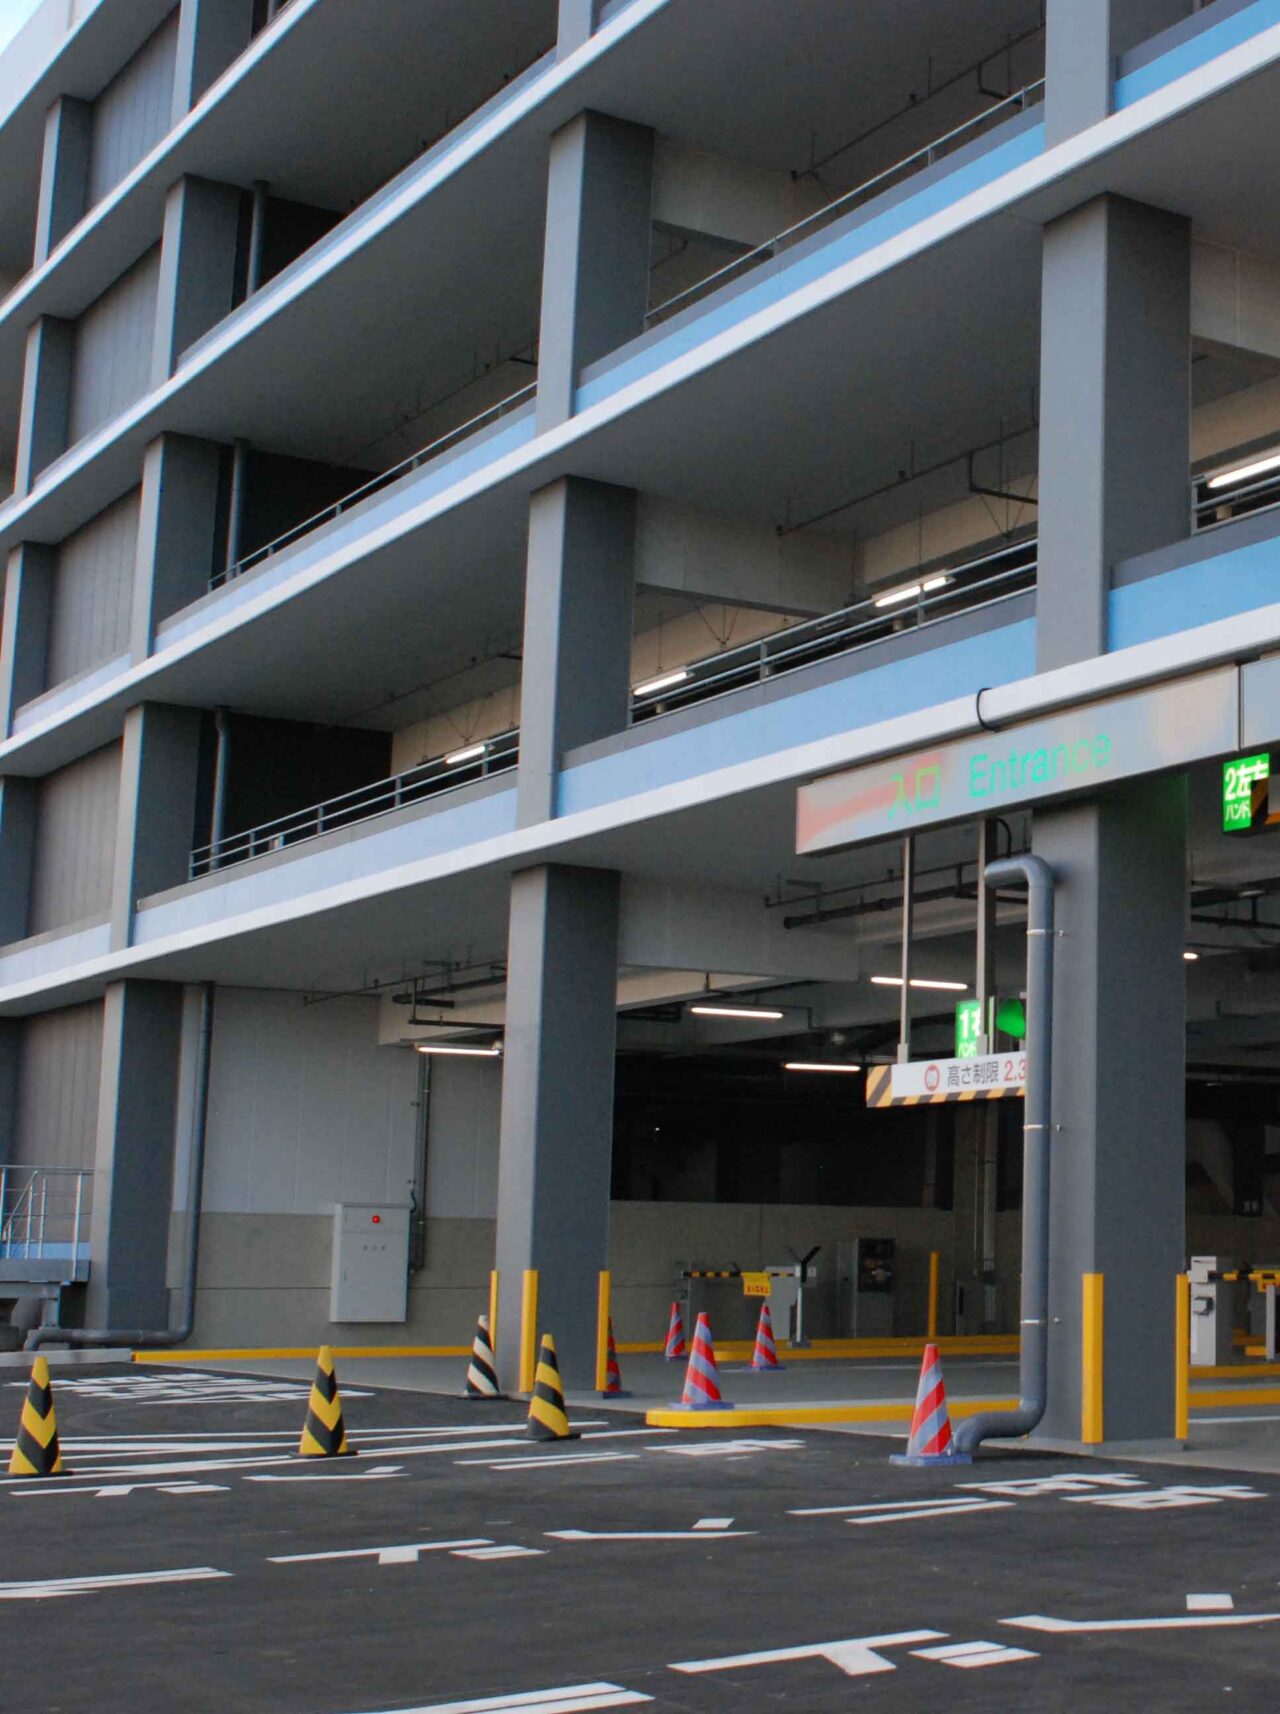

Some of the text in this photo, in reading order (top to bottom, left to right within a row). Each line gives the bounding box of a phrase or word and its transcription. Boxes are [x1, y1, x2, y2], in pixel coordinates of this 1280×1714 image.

[888, 733, 1111, 819] 入口 Entrance
[947, 1061, 999, 1087] 高さ制限
